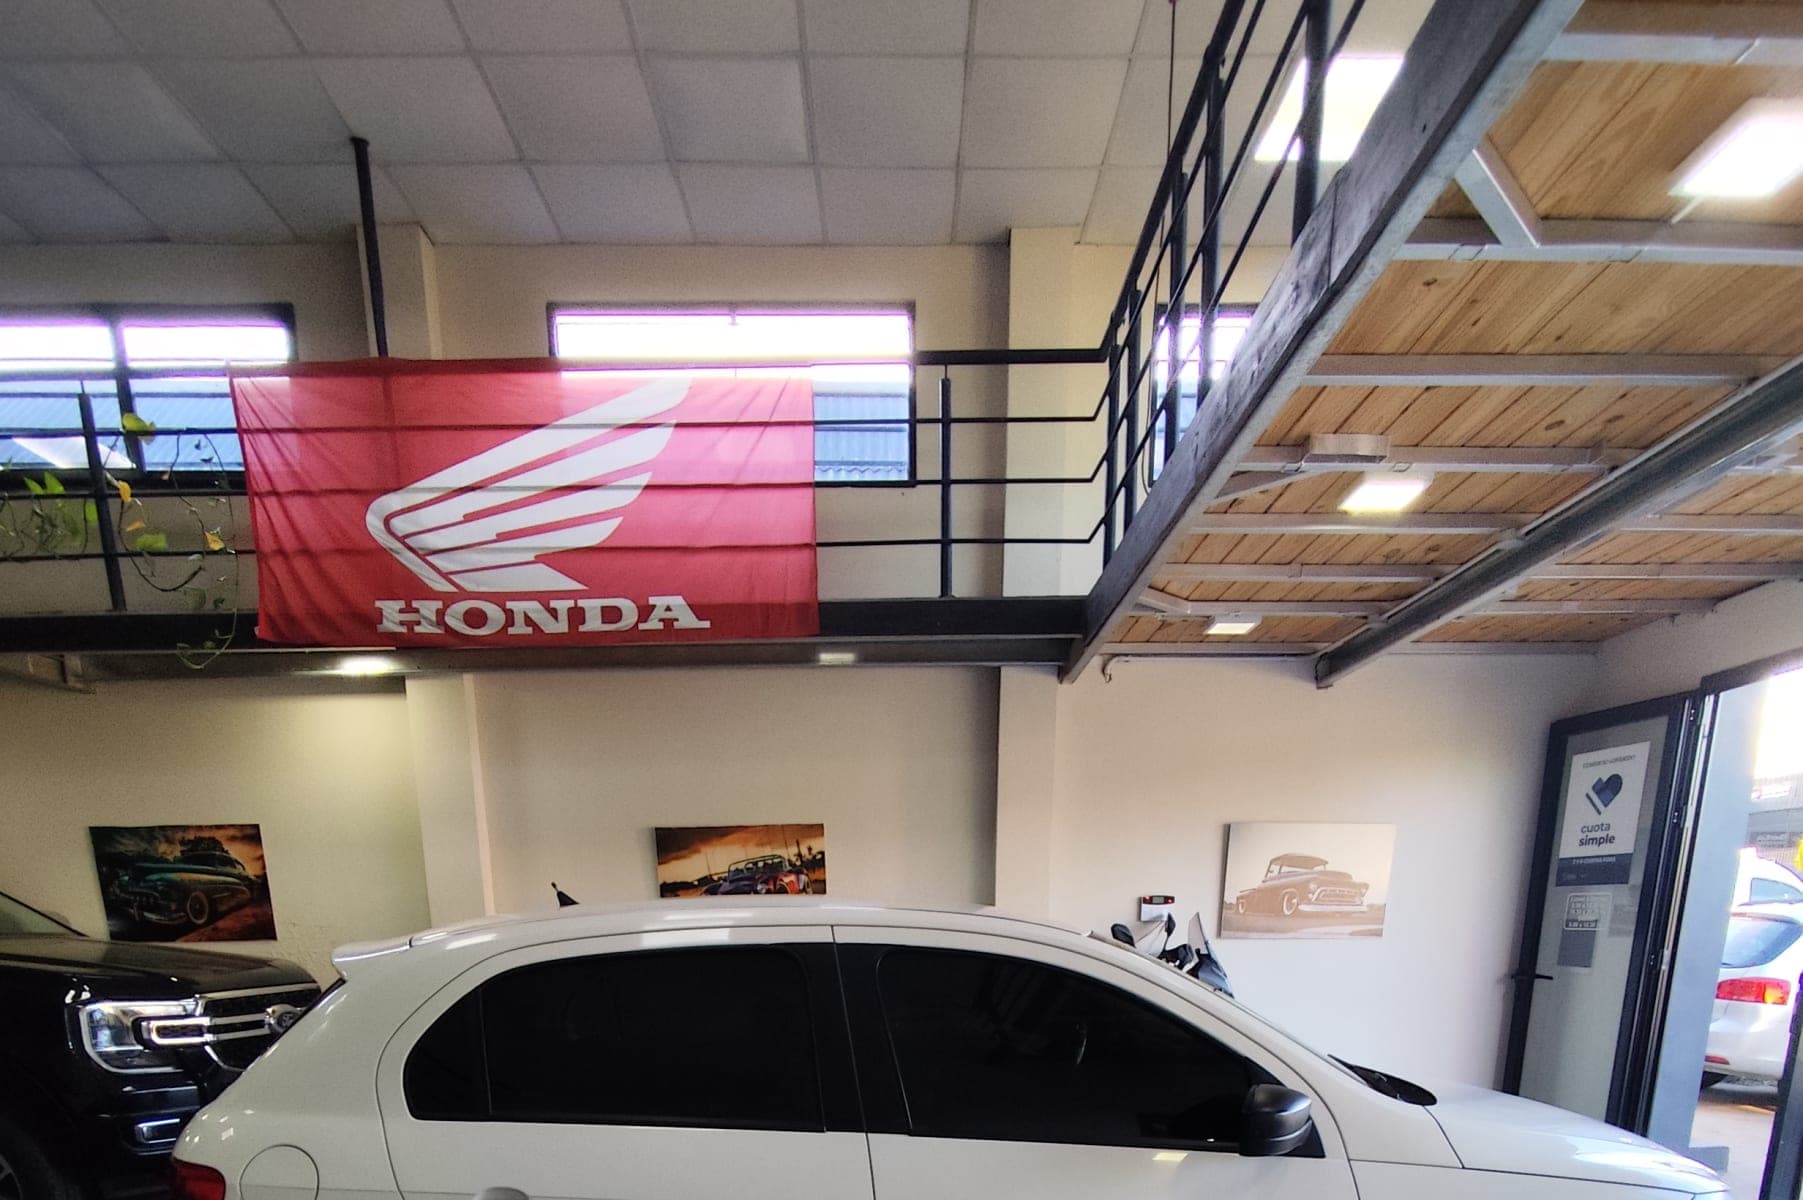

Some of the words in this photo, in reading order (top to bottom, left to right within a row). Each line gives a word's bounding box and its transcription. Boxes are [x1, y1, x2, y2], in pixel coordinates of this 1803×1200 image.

[374, 595, 711, 636] HONDA
[1581, 822, 1611, 833] cuota
[1578, 833, 1616, 848] simple
